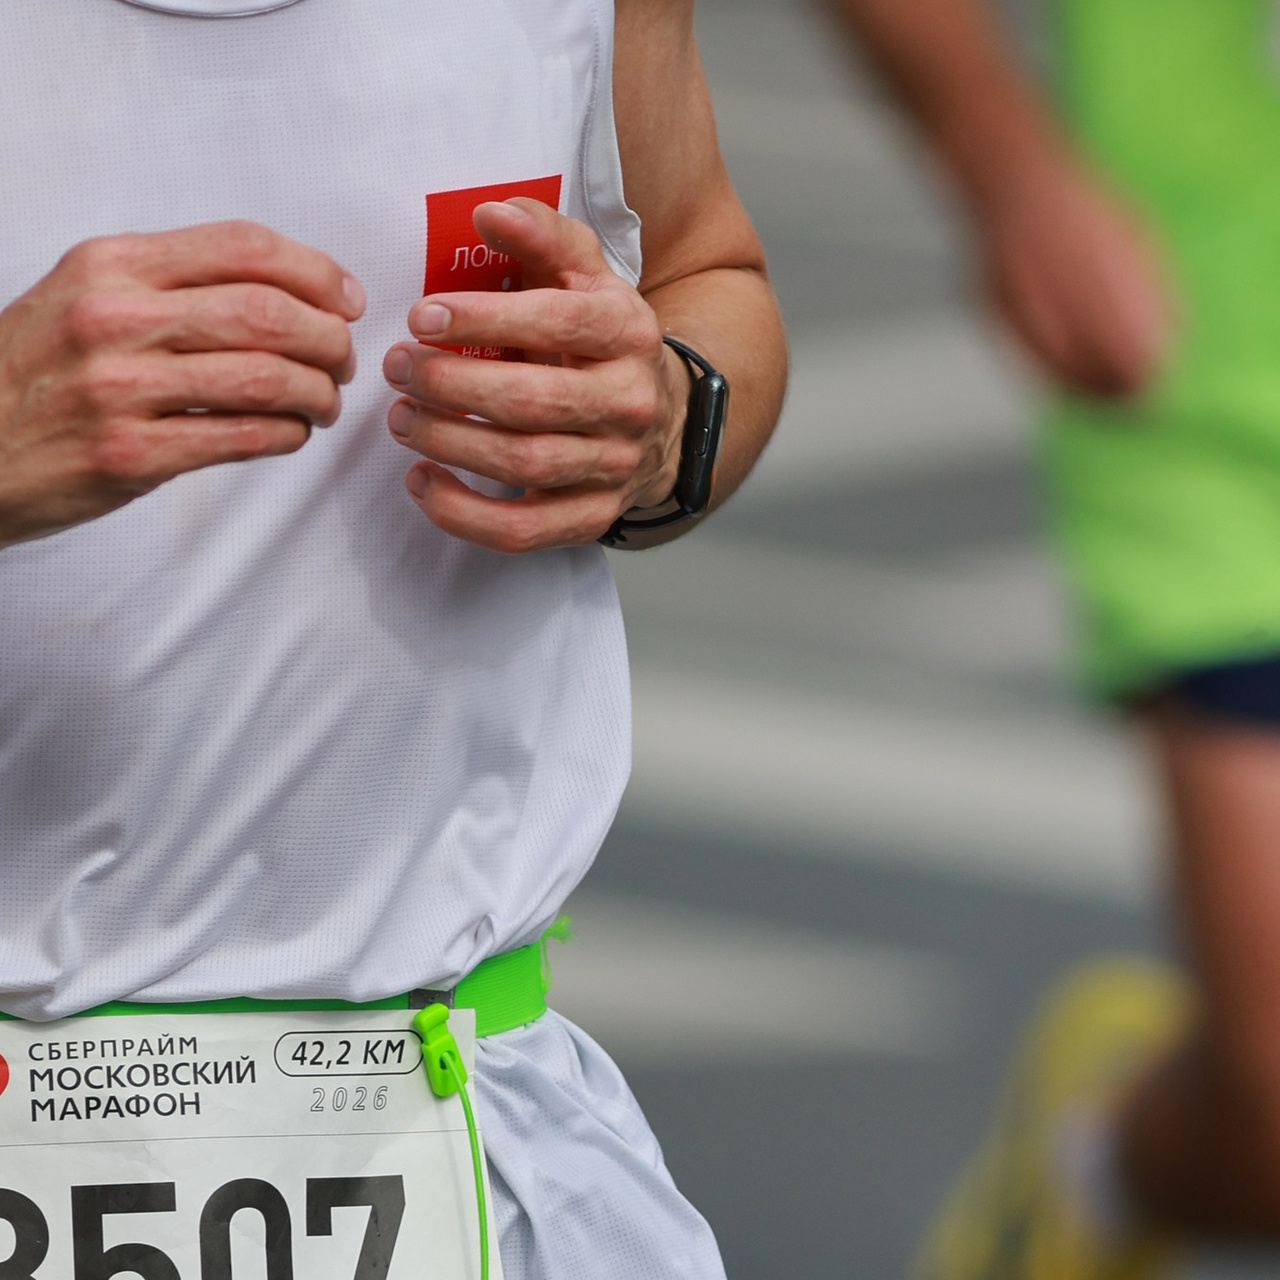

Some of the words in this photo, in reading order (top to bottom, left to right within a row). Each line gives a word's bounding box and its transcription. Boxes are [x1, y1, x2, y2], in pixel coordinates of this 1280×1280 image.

[451, 244, 519, 272] ЛОН
[28, 1033, 198, 1061] СБЕРПРАЙМ
[291, 1039, 352, 1070] 42,2
[362, 1039, 406, 1065] КМ
[29, 1055, 257, 1093] МОСКОВСКИЙ
[31, 1092, 201, 1122] МАРАФОН
[310, 1086, 389, 1112] 2026
